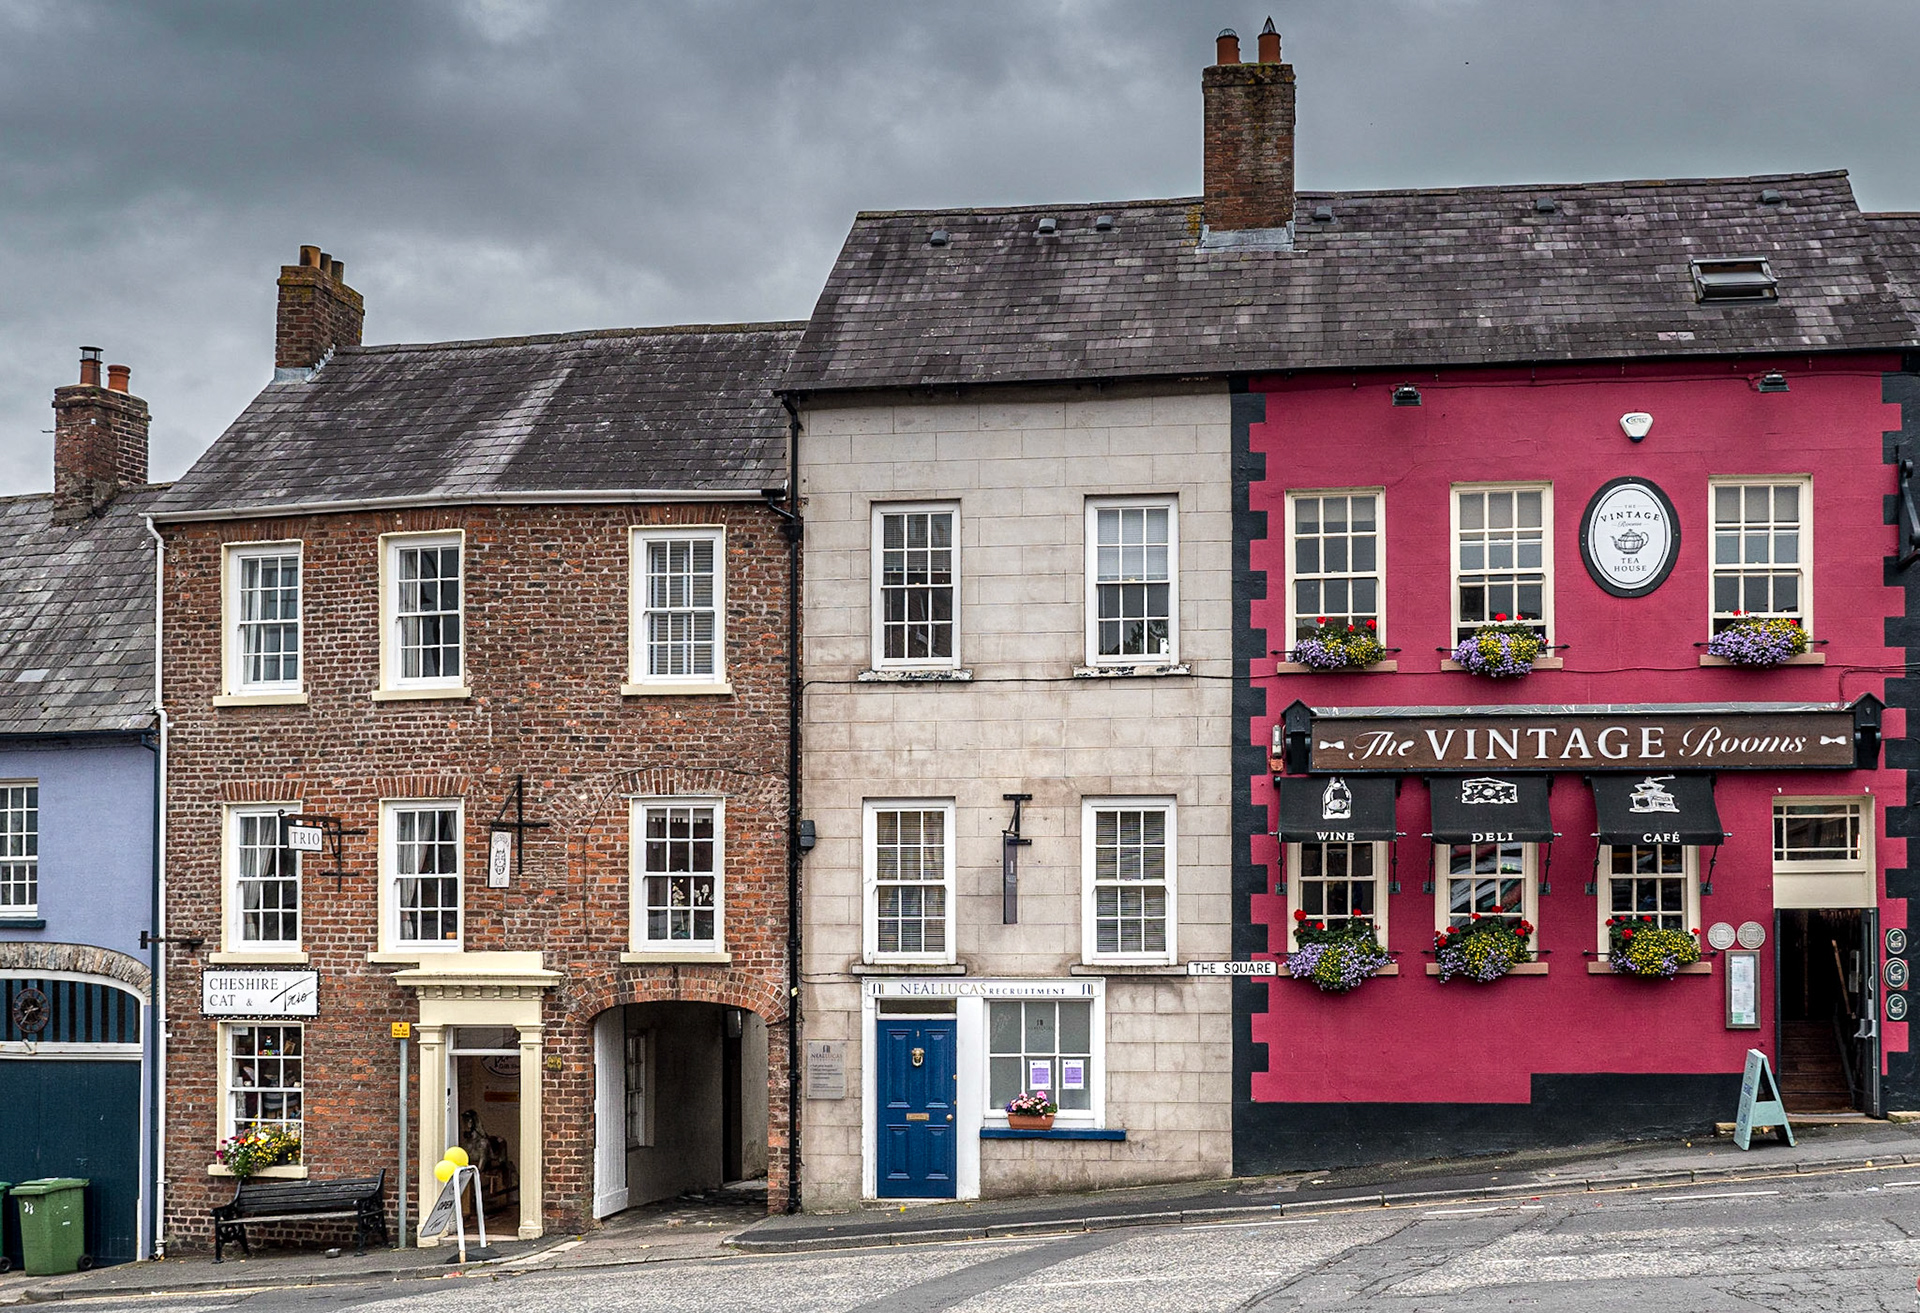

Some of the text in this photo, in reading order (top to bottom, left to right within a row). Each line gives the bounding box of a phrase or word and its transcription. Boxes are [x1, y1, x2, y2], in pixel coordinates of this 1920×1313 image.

[1600, 510, 1660, 522] VINTAGE
[1348, 726, 1807, 761] The VINTAGE Rooms
[291, 832, 320, 845] TRIO
[1316, 831, 1356, 841] WINE
[1472, 832, 1514, 842] DELI
[1643, 831, 1681, 843] CAFÉ
[1194, 963, 1271, 974] THE SQUARE
[209, 977, 279, 990] CHESHIRE
[209, 994, 236, 1006] CAT
[246, 998, 253, 1006] &
